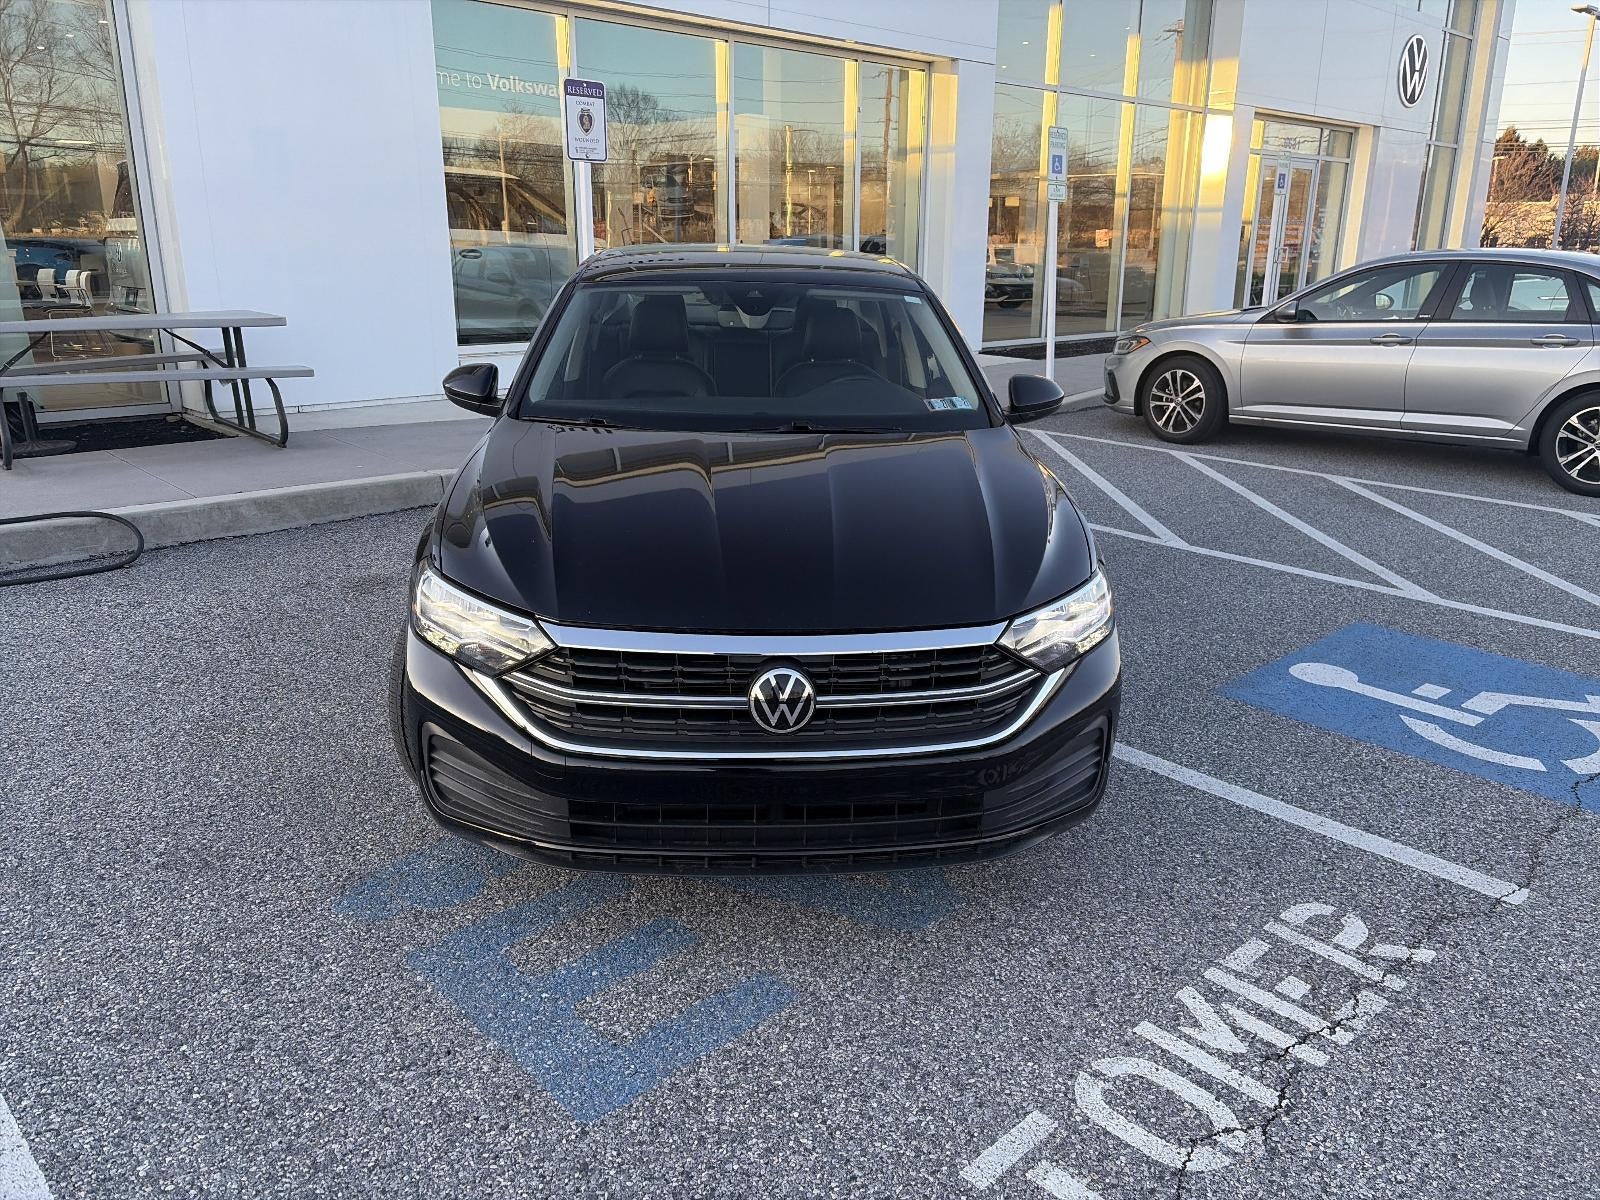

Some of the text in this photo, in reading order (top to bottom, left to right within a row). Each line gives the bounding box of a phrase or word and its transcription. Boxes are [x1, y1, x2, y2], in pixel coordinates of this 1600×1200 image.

[466, 72, 482, 89] to
[486, 72, 560, 98] Volkswa
[567, 85, 603, 97] RESERVED
[1398, 33, 1429, 108] VW
[749, 667, 815, 734] VW
